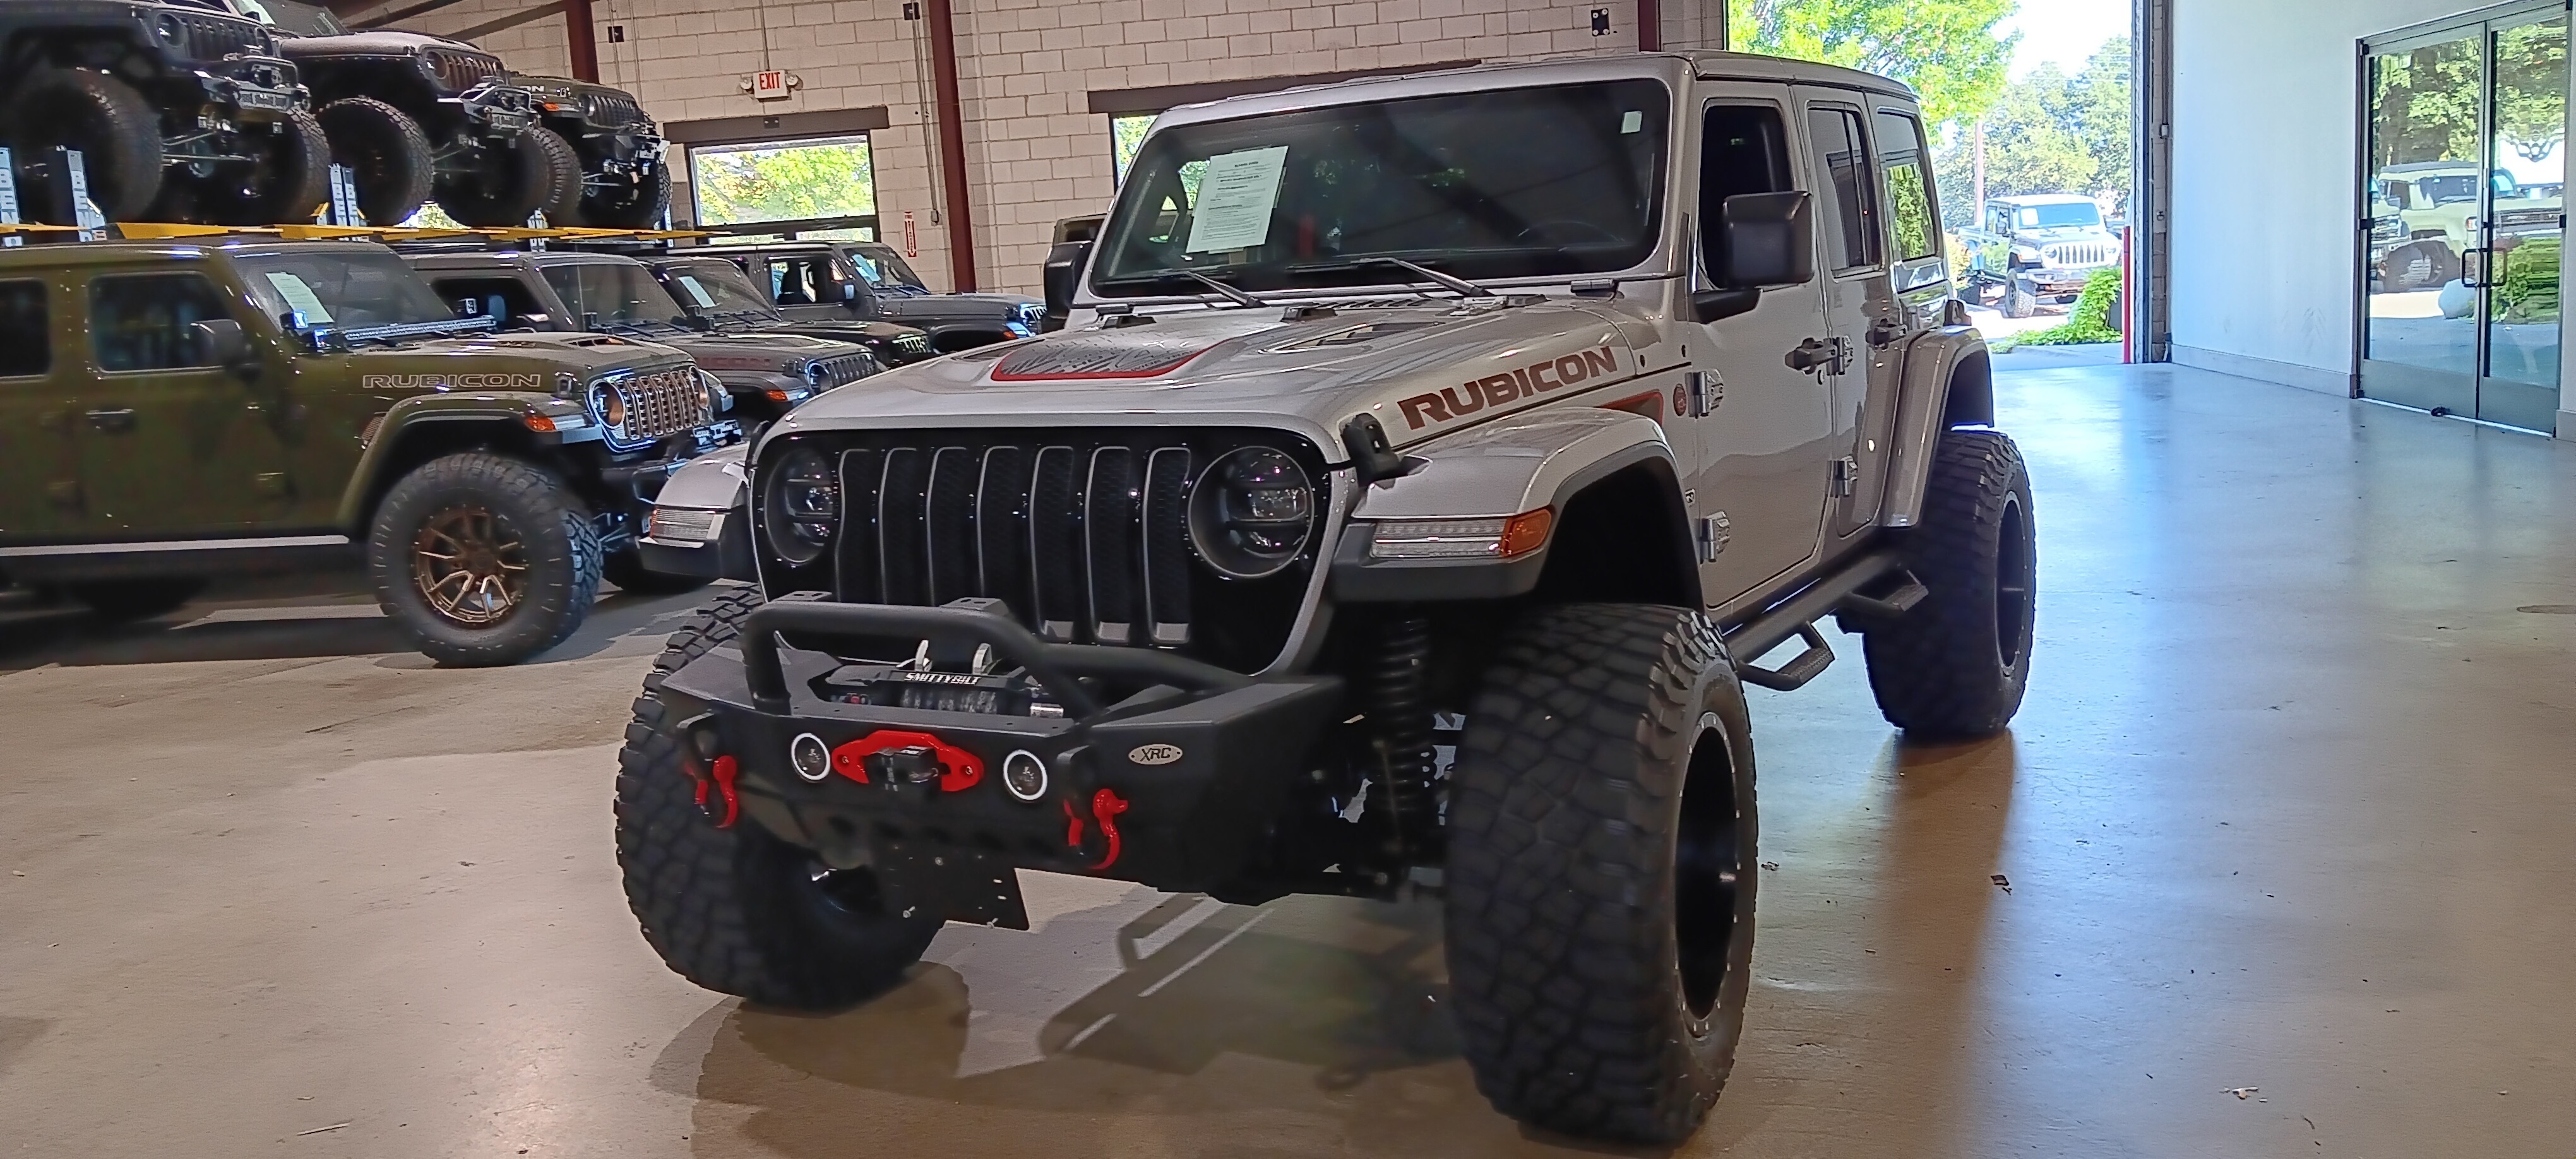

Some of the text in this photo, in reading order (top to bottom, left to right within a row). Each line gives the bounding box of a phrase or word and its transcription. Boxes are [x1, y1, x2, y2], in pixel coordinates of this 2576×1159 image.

[759, 71, 780, 90] EXIT
[362, 374, 541, 388] RUBICON
[1397, 345, 1618, 431] RUBICON
[903, 672, 982, 685] SMITTYBILT
[1139, 747, 1172, 762] XRC
